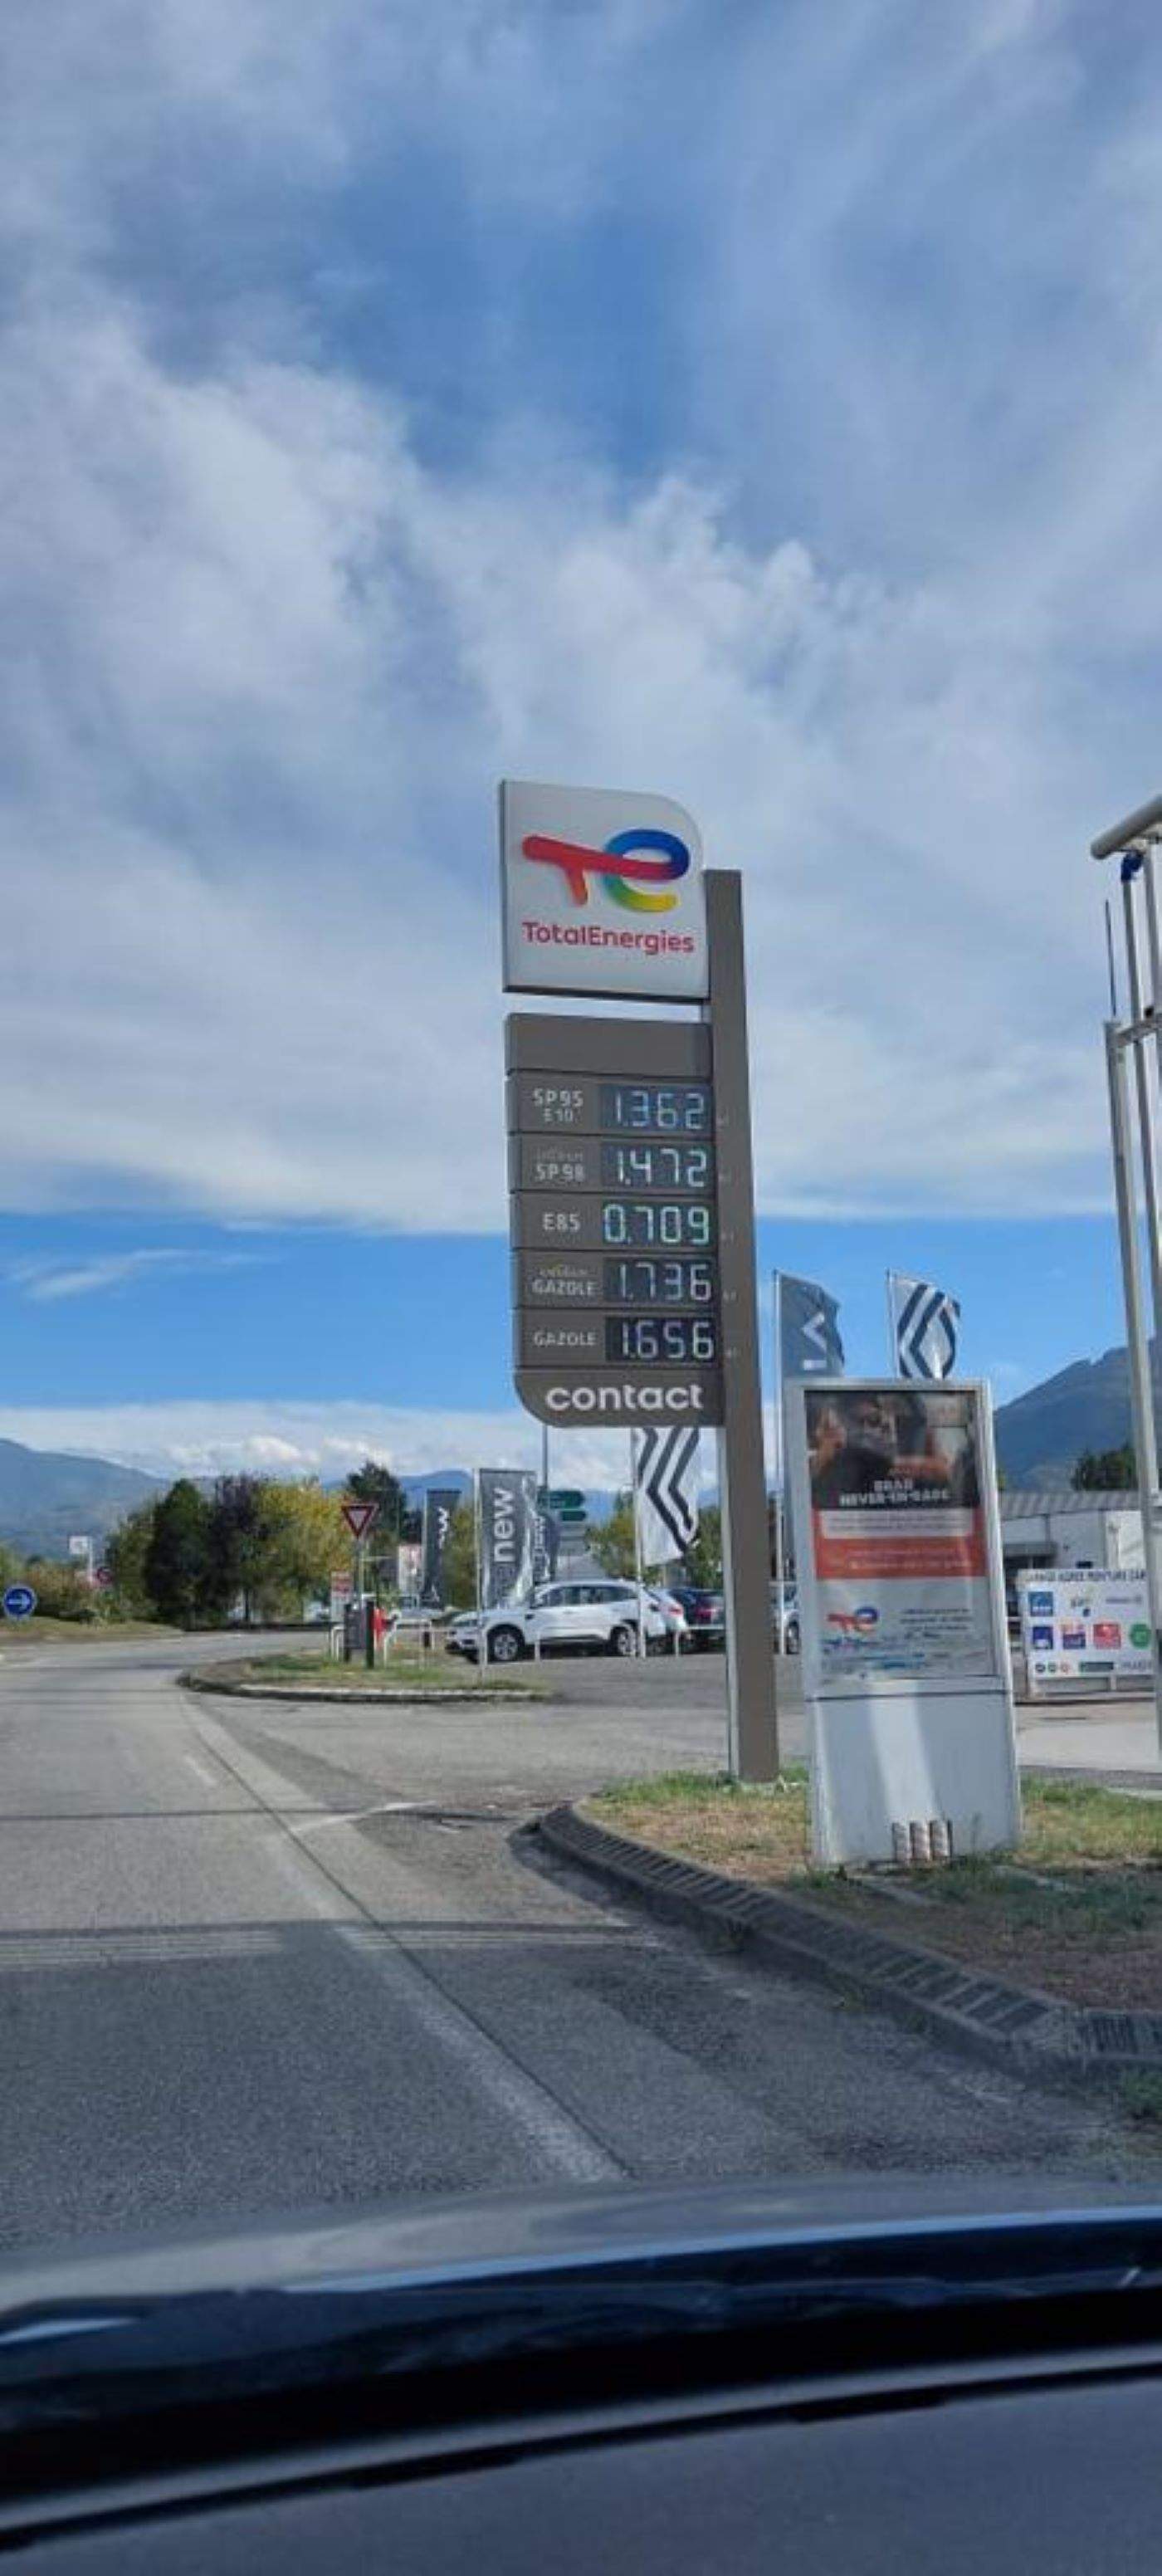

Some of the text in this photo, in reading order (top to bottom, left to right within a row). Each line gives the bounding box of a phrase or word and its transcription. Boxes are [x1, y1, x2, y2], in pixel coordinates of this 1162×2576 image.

[522, 921, 694, 955] TotalEnergies
[614, 1090, 705, 1130] 1.362
[618, 1148, 706, 1187] 1.472
[543, 1204, 710, 1244] E85 0.709
[531, 1278, 595, 1296] GAZOLE
[620, 1263, 711, 1301] 1.736
[534, 1330, 596, 1347] GAZOLE
[622, 1322, 714, 1359] 1.656
[544, 1384, 703, 1410] contact
[494, 1487, 515, 1562] new
